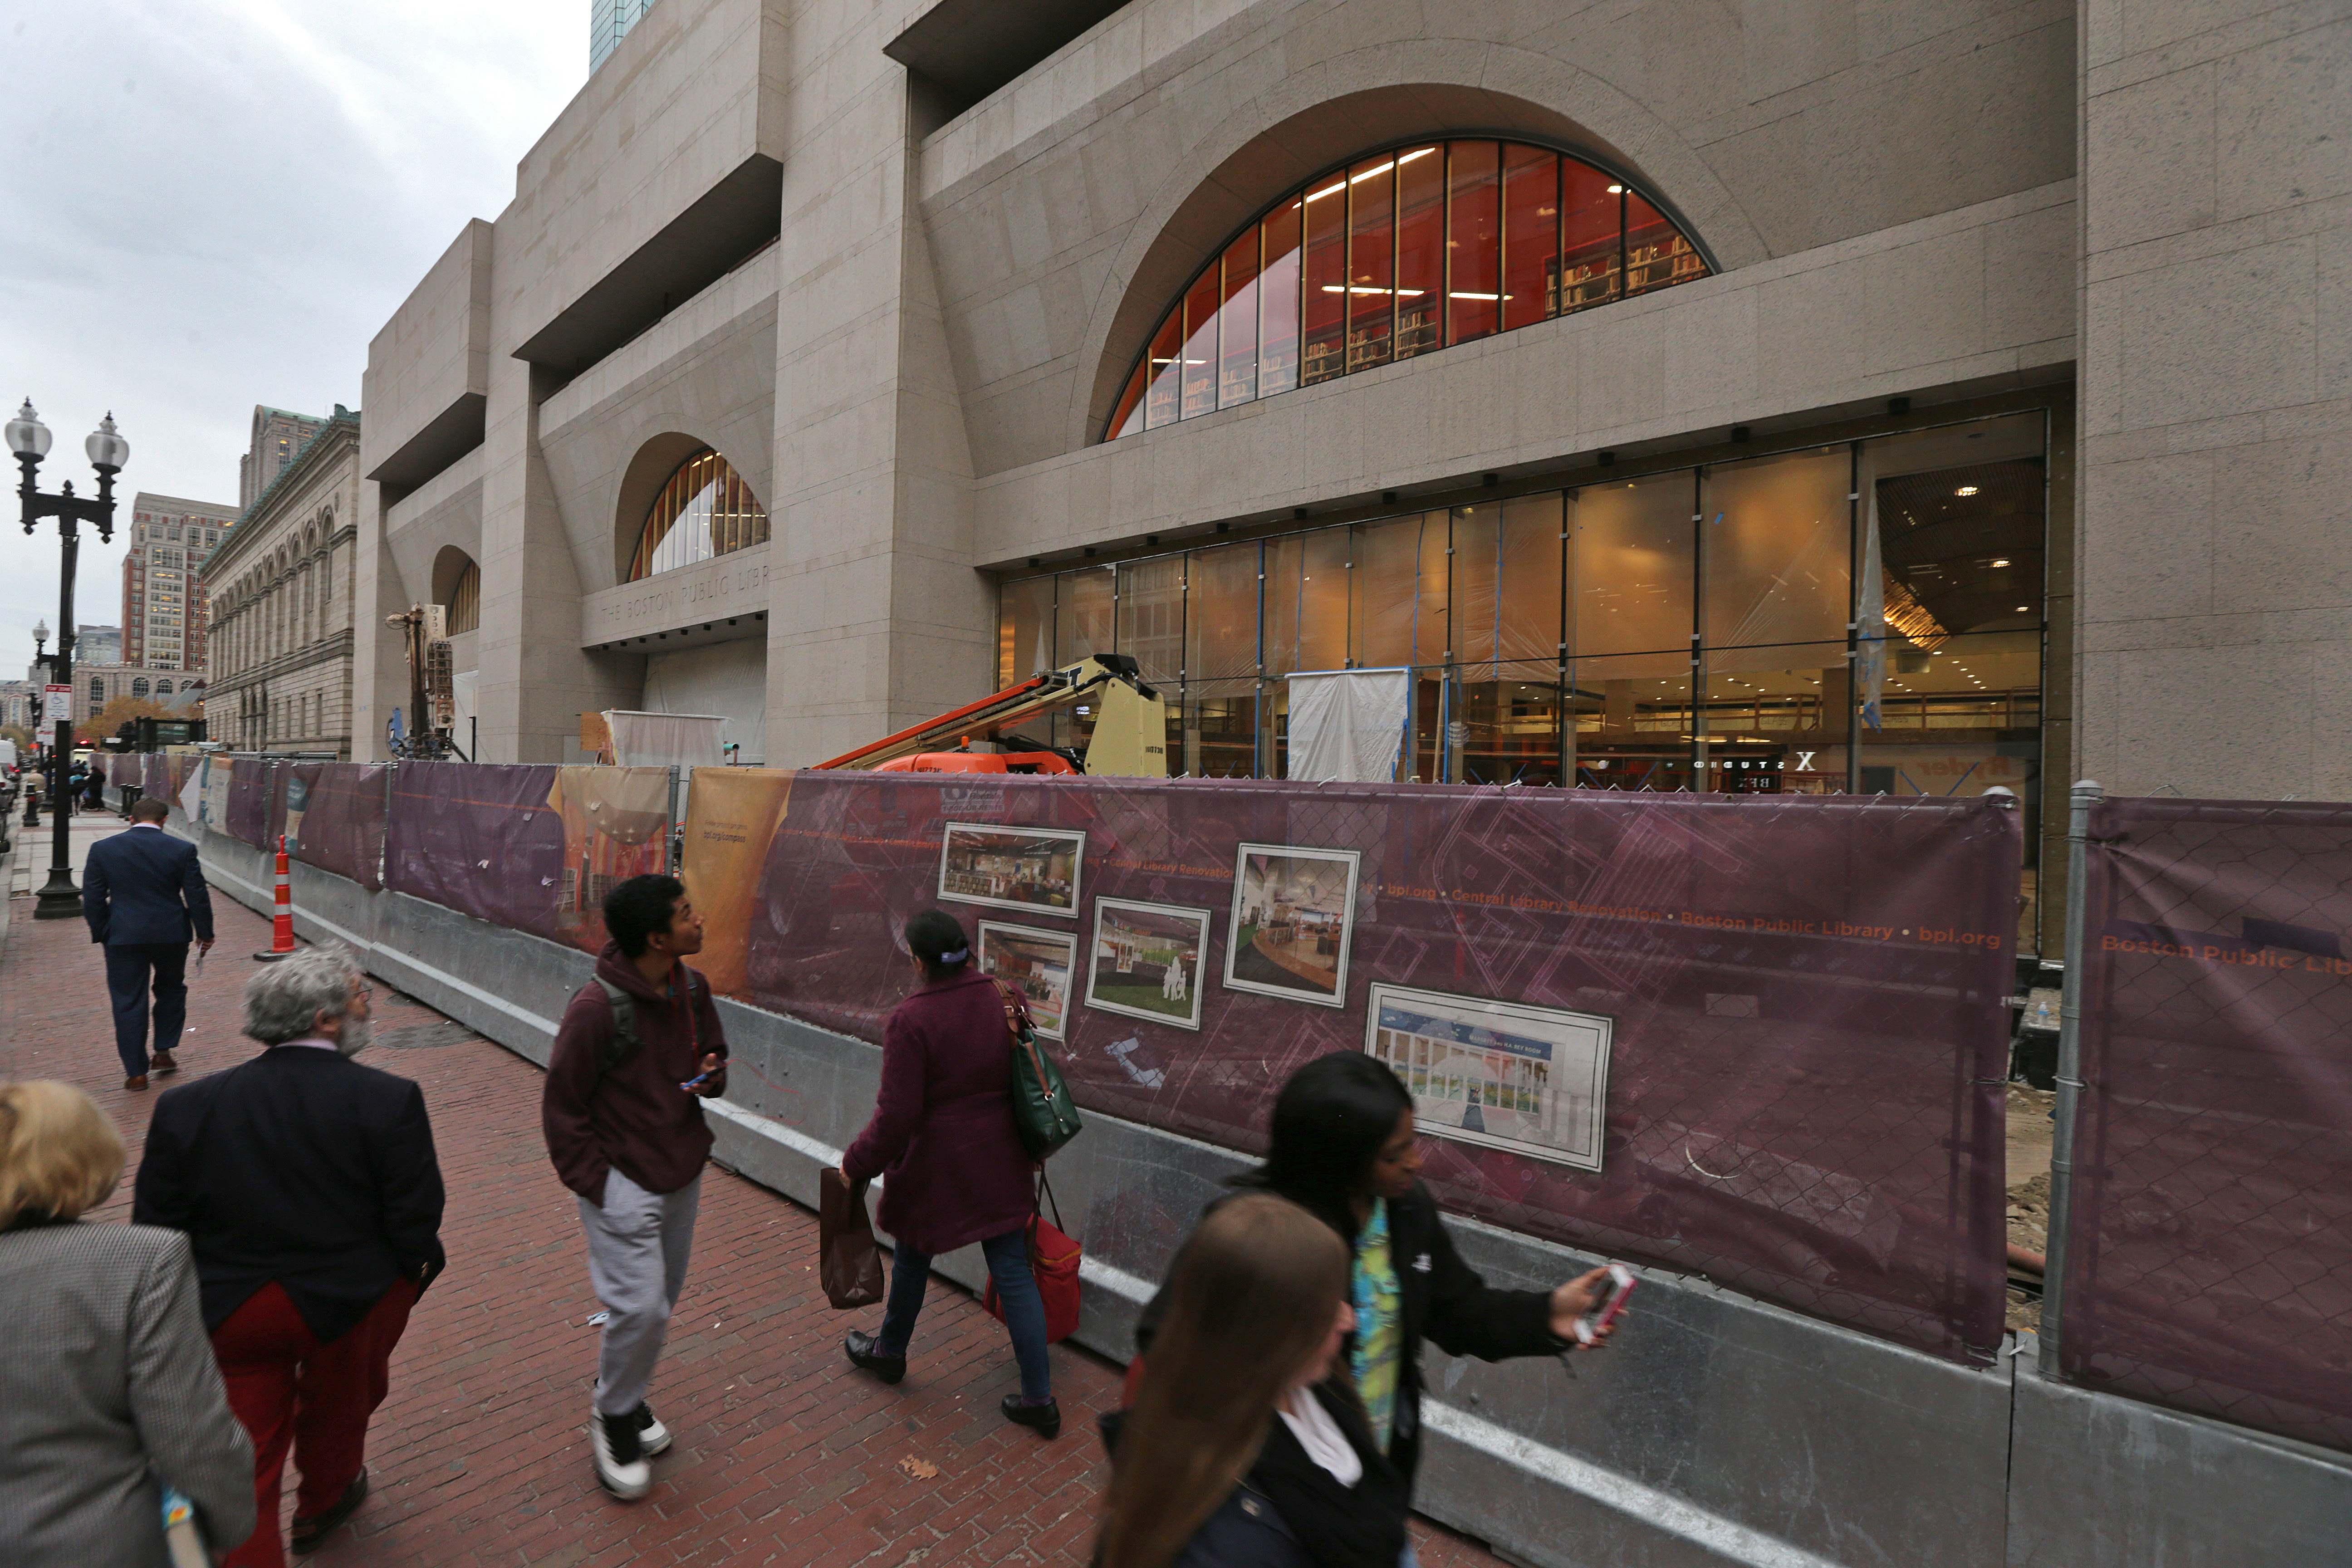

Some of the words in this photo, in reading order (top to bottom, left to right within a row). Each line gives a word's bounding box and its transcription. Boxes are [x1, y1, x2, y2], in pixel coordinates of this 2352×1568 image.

[601, 605, 621, 623] THE
[627, 591, 673, 617] BOSTON
[681, 576, 728, 604] PUBLIC
[1109, 857, 1141, 869] Central
[1143, 861, 1178, 874] Library
[1387, 883, 1436, 901] bpl.org
[1452, 889, 1505, 905] Central
[1510, 894, 1564, 914] Library
[1568, 900, 1661, 921] Renovation
[1681, 911, 1747, 930] Boston
[1753, 918, 1815, 933] Public
[1822, 921, 1894, 941] Library
[1919, 926, 2001, 950] bpl.org
[2102, 935, 2195, 959] Boston
[2203, 945, 2294, 970] Public
